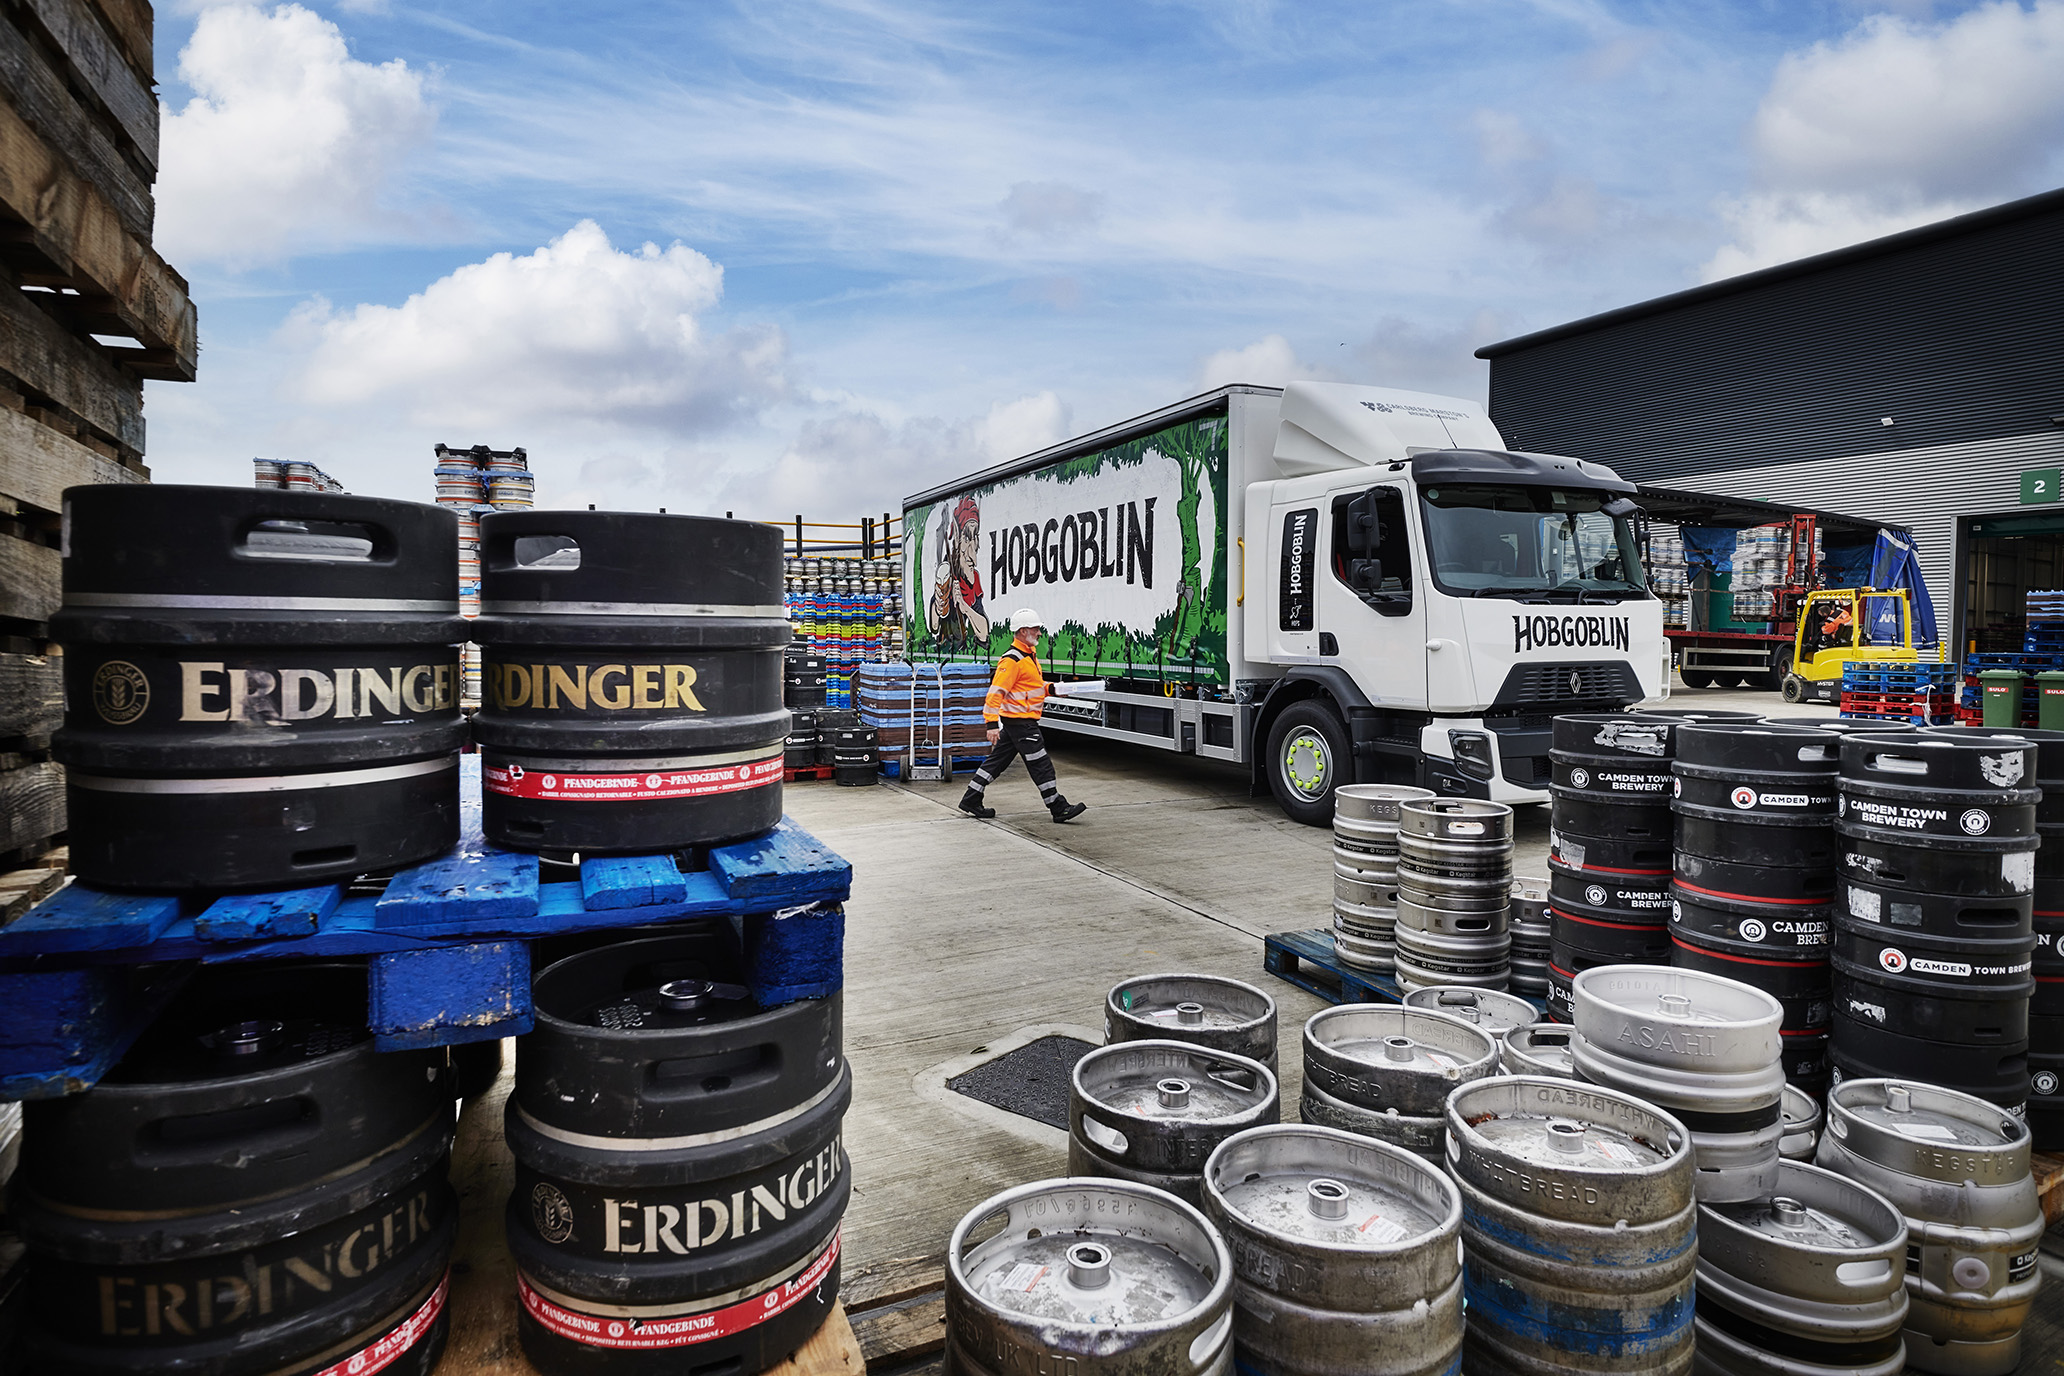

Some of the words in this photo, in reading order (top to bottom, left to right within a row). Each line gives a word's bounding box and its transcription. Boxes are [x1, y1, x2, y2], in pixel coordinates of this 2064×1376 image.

[2033, 480, 2046, 494] 2
[989, 497, 1158, 601] HOBGOBLIN
[1290, 514, 1308, 596] HOBGOBLIN
[1511, 615, 1629, 654] HOBGOBLIN
[487, 664, 707, 712] RDINGER
[563, 778, 638, 789] PFANDGEBINDE
[670, 770, 735, 786] PFANDGEBINDE
[1598, 772, 1645, 783] CAMDEN
[1646, 775, 1676, 783] TOWN
[1611, 781, 1665, 791] BREWERY
[1763, 795, 1807, 804] CAMDEN
[1810, 796, 1832, 804] TOWN
[1369, 804, 1398, 814] KEGS
[1850, 800, 1898, 816] CAMDEN
[1899, 807, 1947, 821] TOWN
[1861, 812, 1927, 829] BREWERY
[1375, 848, 1398, 856] Kegstar
[1420, 867, 1439, 876] Kegstar
[1455, 871, 1476, 879] Kegstar
[1616, 890, 1661, 900] CAMDEN
[1663, 892, 1674, 900] TO
[1631, 900, 1673, 908] BREWER
[1772, 921, 1830, 934] CAMDEN
[1427, 963, 1450, 972] Kegstar
[1463, 967, 1485, 975] Kegstar
[1914, 961, 1967, 974] CAMDEN
[1974, 966, 2006, 975] TOWN
[1555, 987, 1575, 1003] CAM
[1617, 1022, 1717, 1057] ASAHI
[1915, 1149, 2014, 1175] KEGSTAR
[603, 1134, 842, 1255] ERDINGER
[97, 1190, 431, 1337] ERDINGER
[541, 1303, 600, 1333] PFANDGEBINDE
[633, 1315, 715, 1337] PFANDGEBINDE
[996, 1338, 1020, 1368] UK
[1036, 1351, 1080, 1376] LTD
